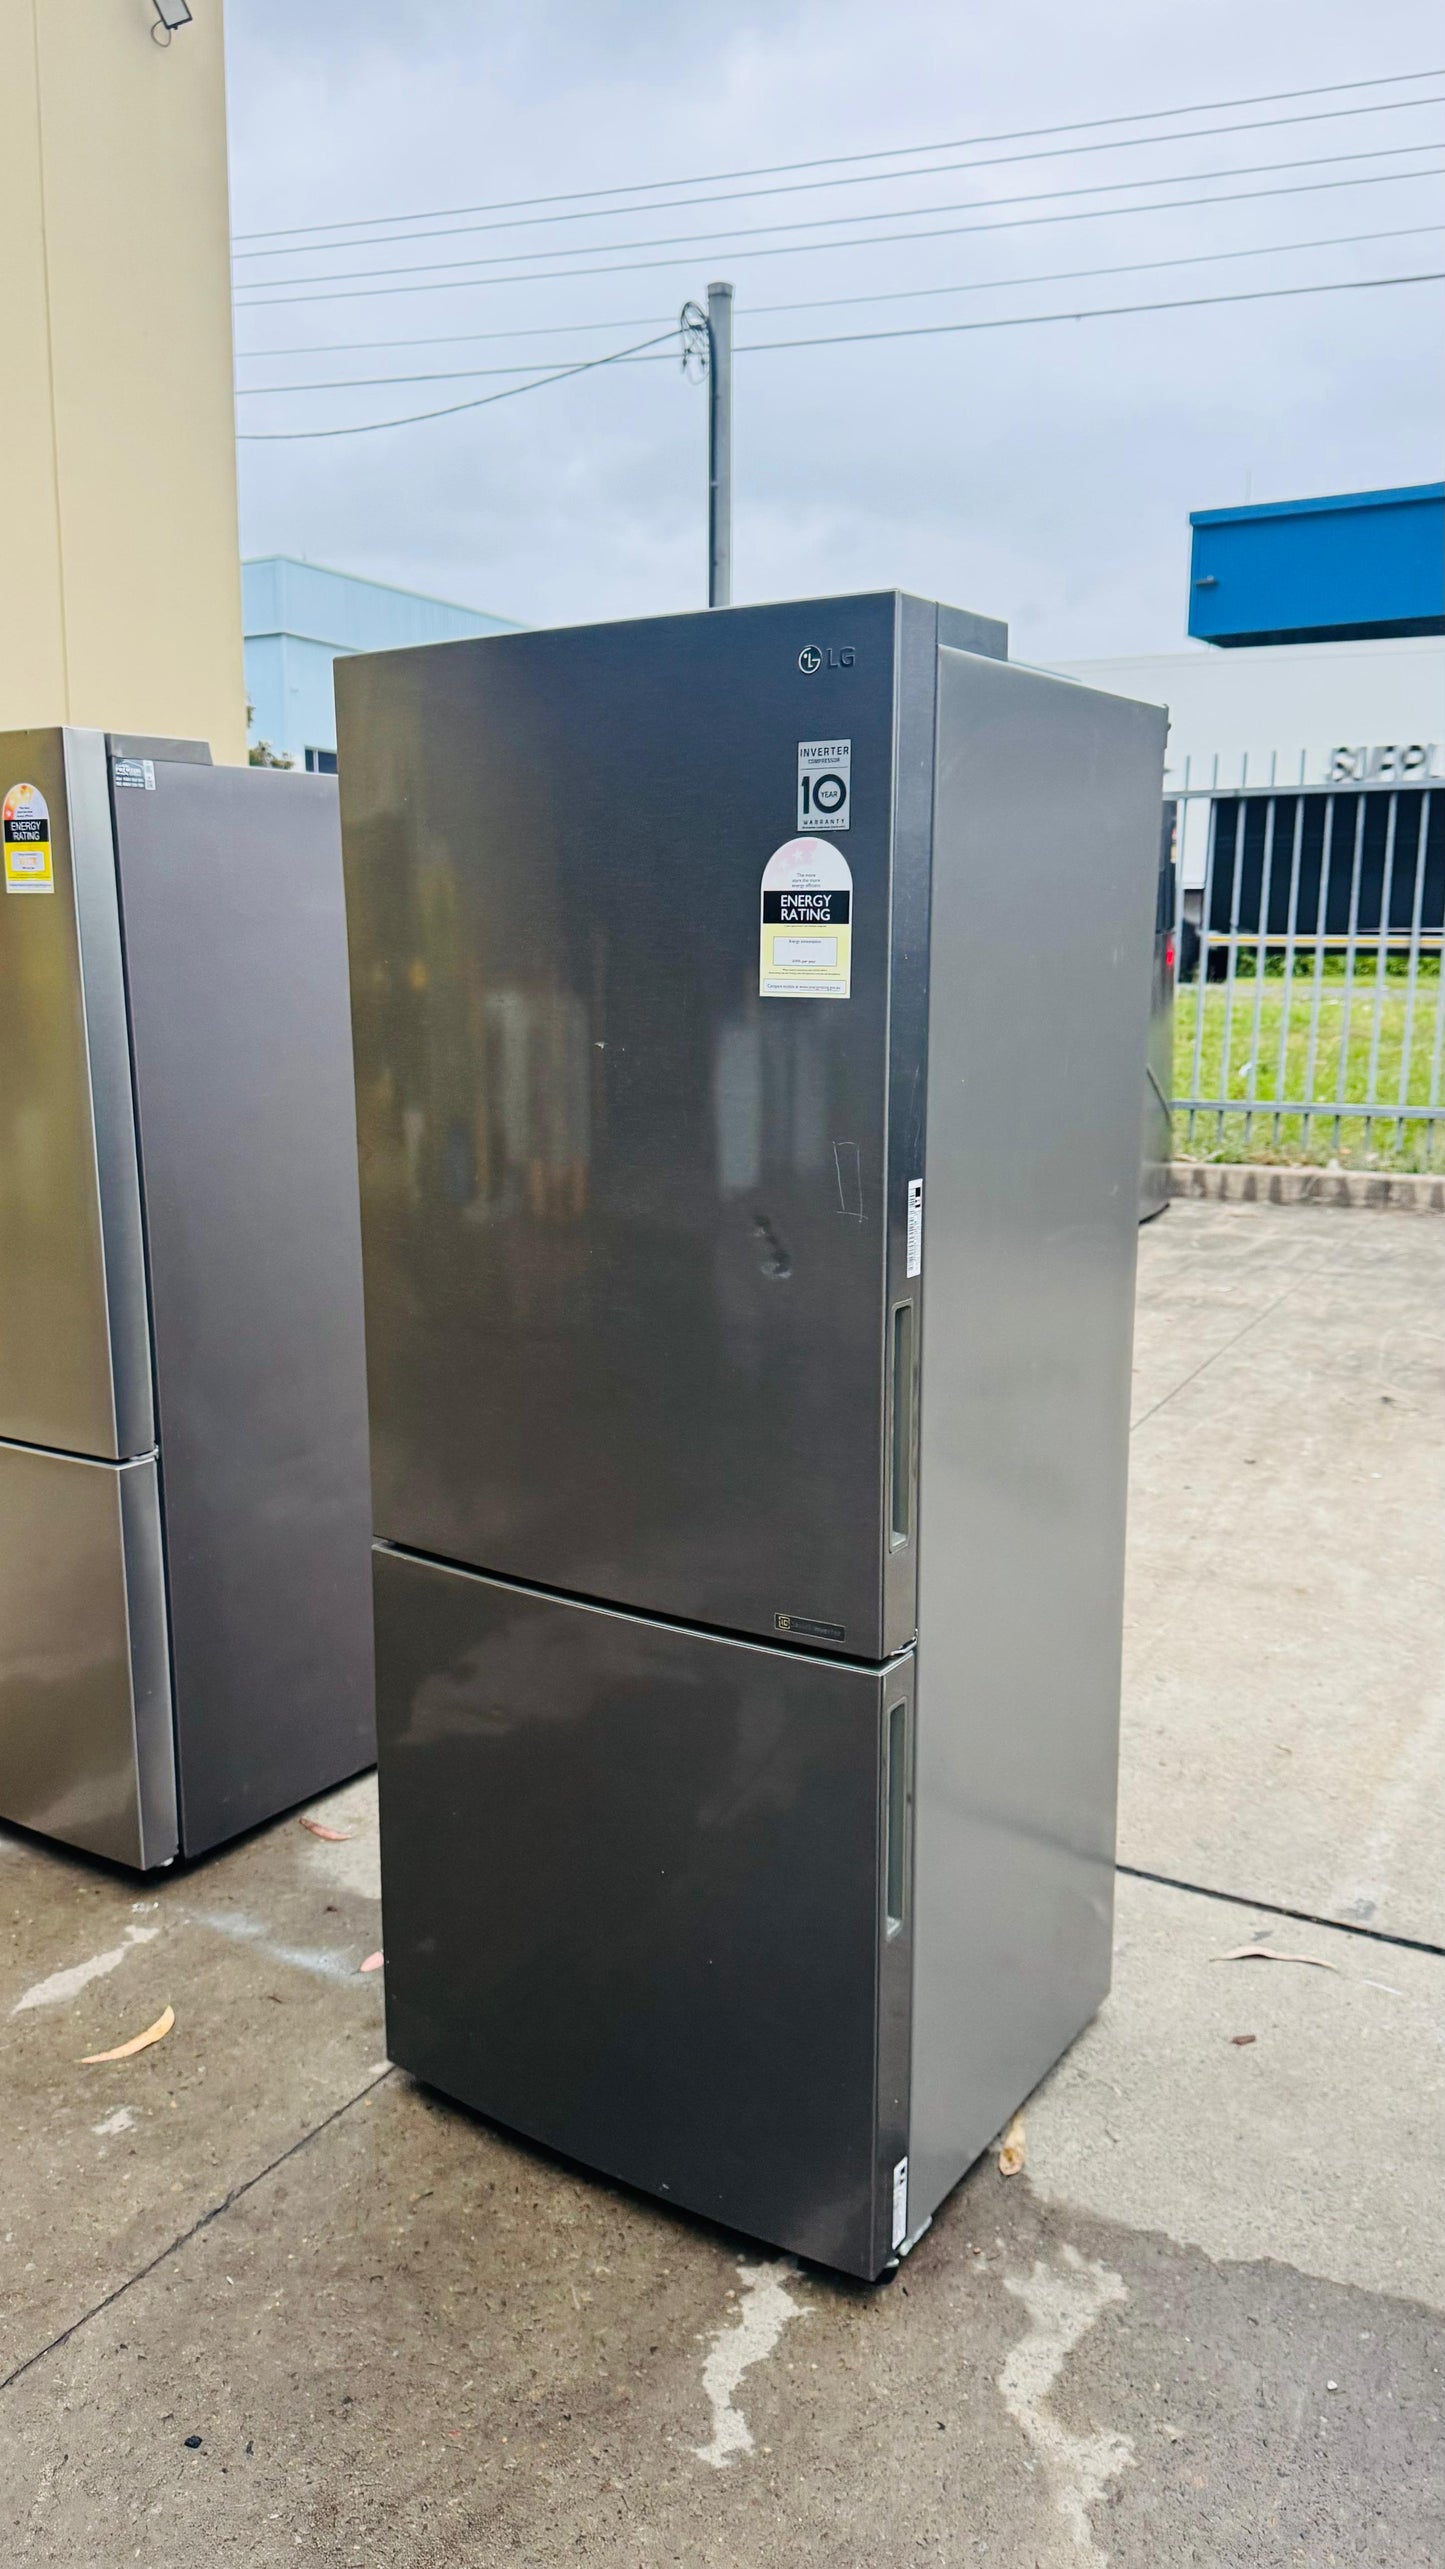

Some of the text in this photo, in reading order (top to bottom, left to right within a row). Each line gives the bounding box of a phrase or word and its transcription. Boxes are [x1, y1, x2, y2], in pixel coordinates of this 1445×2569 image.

[826, 646, 856, 667] LG
[800, 746, 850, 757] INVERTER
[801, 773, 847, 815] 10
[821, 791, 838, 799] YEAR
[10, 821, 41, 831] ENERGY
[12, 831, 41, 841] RATING
[780, 894, 832, 907] ENERGY
[780, 908, 832, 921] RATING
